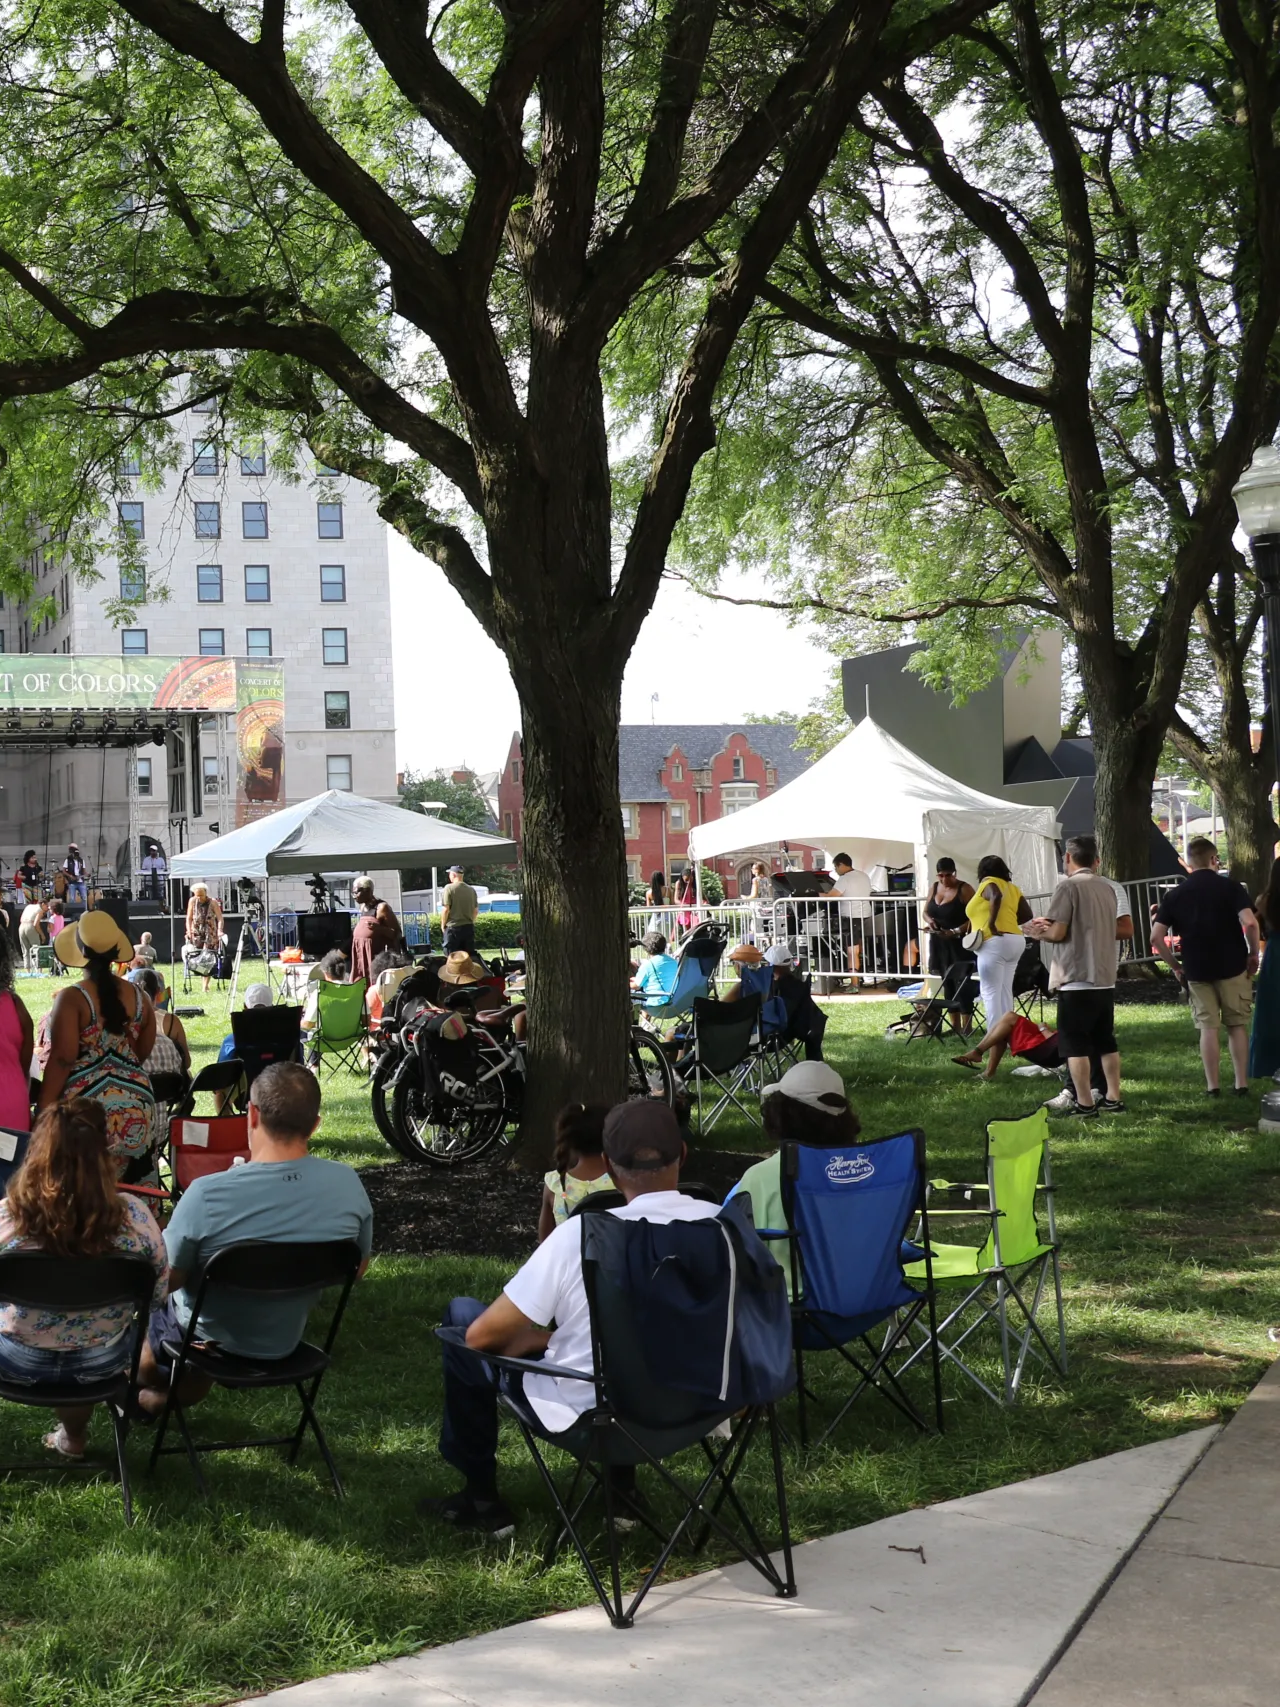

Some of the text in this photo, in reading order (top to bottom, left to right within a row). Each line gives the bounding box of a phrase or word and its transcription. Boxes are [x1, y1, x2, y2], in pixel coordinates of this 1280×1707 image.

[22, 673, 51, 692] OF
[58, 673, 157, 693] COLORS
[239, 678, 272, 686] CONCERT
[239, 687, 283, 698] COLORS
